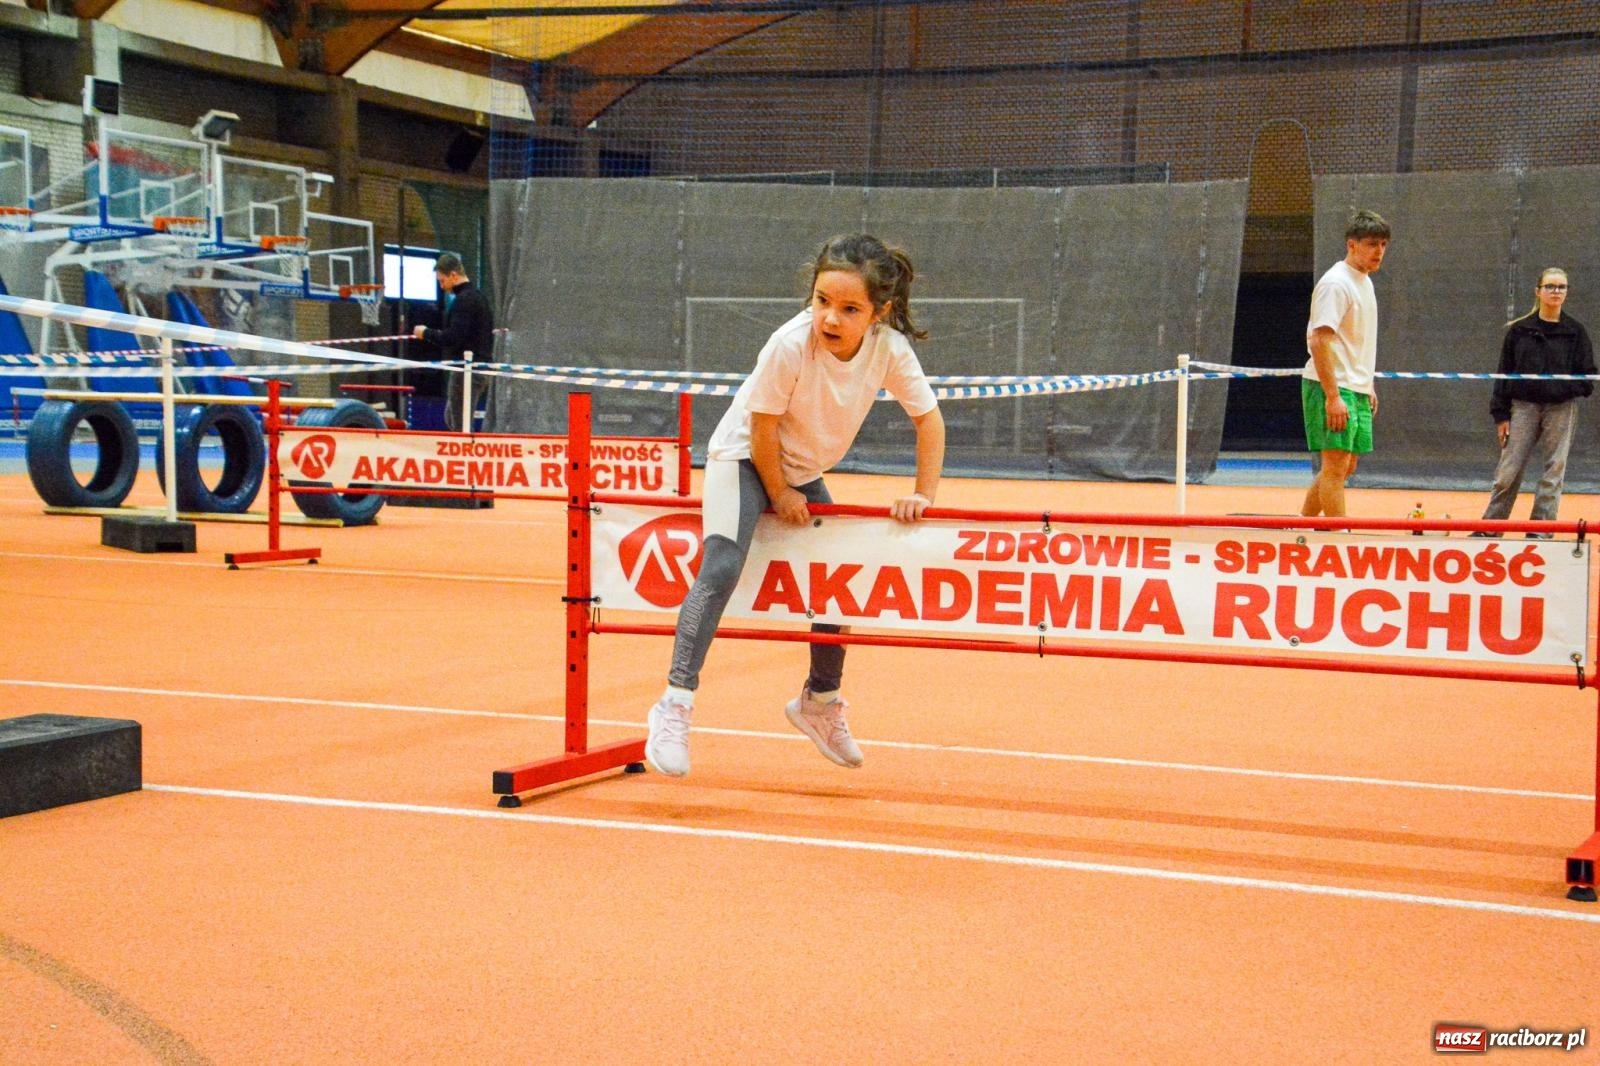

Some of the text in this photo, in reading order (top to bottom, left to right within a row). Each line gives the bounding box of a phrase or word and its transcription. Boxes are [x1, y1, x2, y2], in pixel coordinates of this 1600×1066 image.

[351, 455, 663, 491] AKADEMIA RCHU
[436, 441, 523, 458] ZDROWIE
[539, 443, 662, 462] SPWNOŚĆ
[953, 530, 1171, 570] ZDROWIE
[1214, 540, 1546, 587] SPRAWNOŚĆ
[751, 559, 1545, 656] AKADEMIA RUCHU
